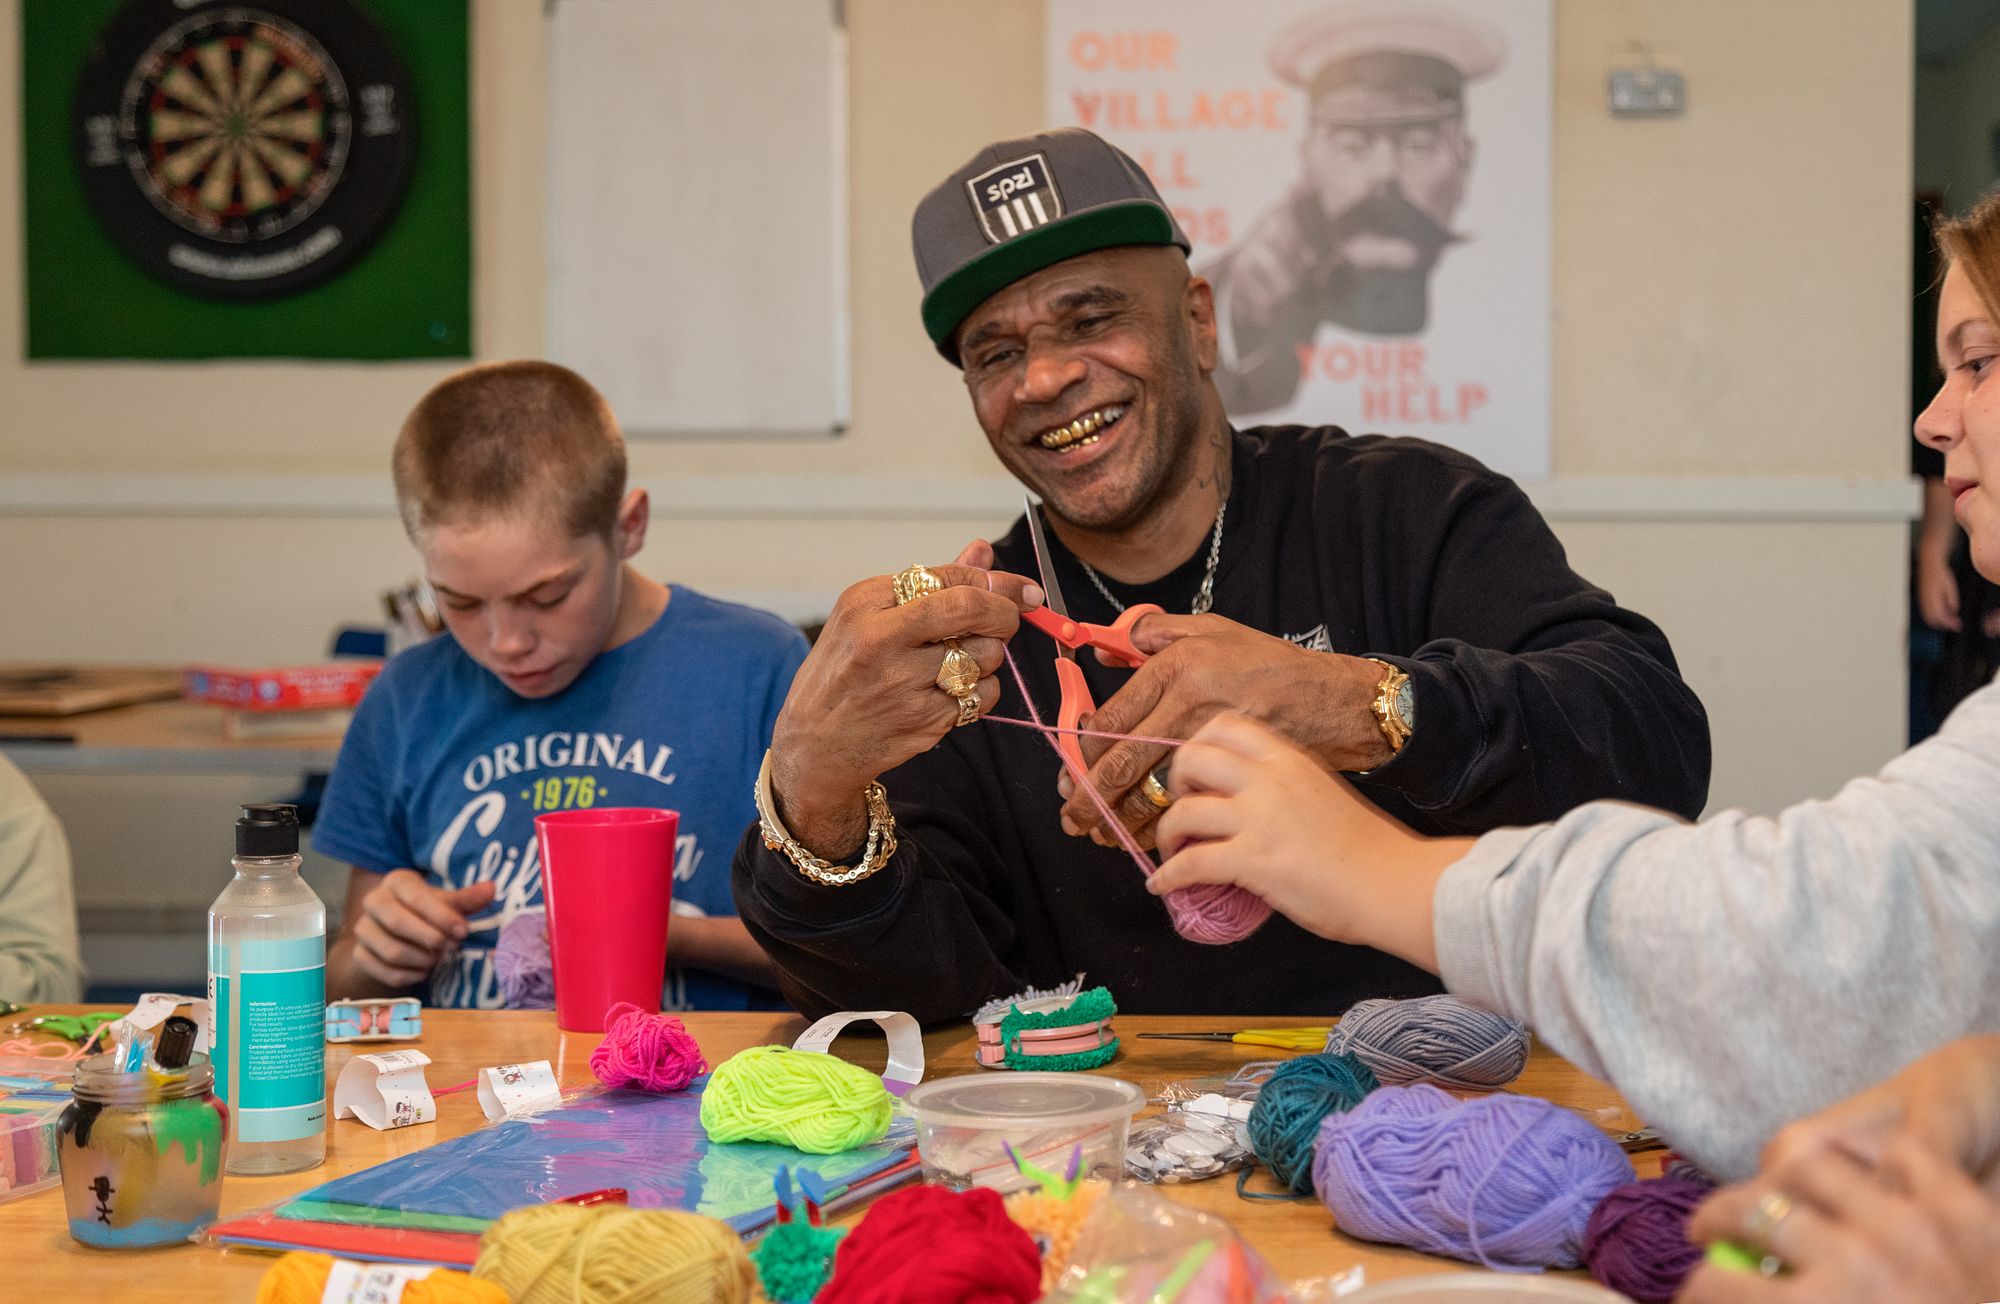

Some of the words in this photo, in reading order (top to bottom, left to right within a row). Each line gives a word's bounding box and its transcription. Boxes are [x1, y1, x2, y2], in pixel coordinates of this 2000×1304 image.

[1069, 31, 1178, 72] OUR
[1071, 91, 1289, 132] VILLAGE
[987, 166, 1035, 202] spzl
[1141, 150, 1199, 190] LL
[1297, 342, 1427, 382] YOUR
[1362, 384, 1490, 424] HELP
[463, 731, 676, 792] ORIGINAL
